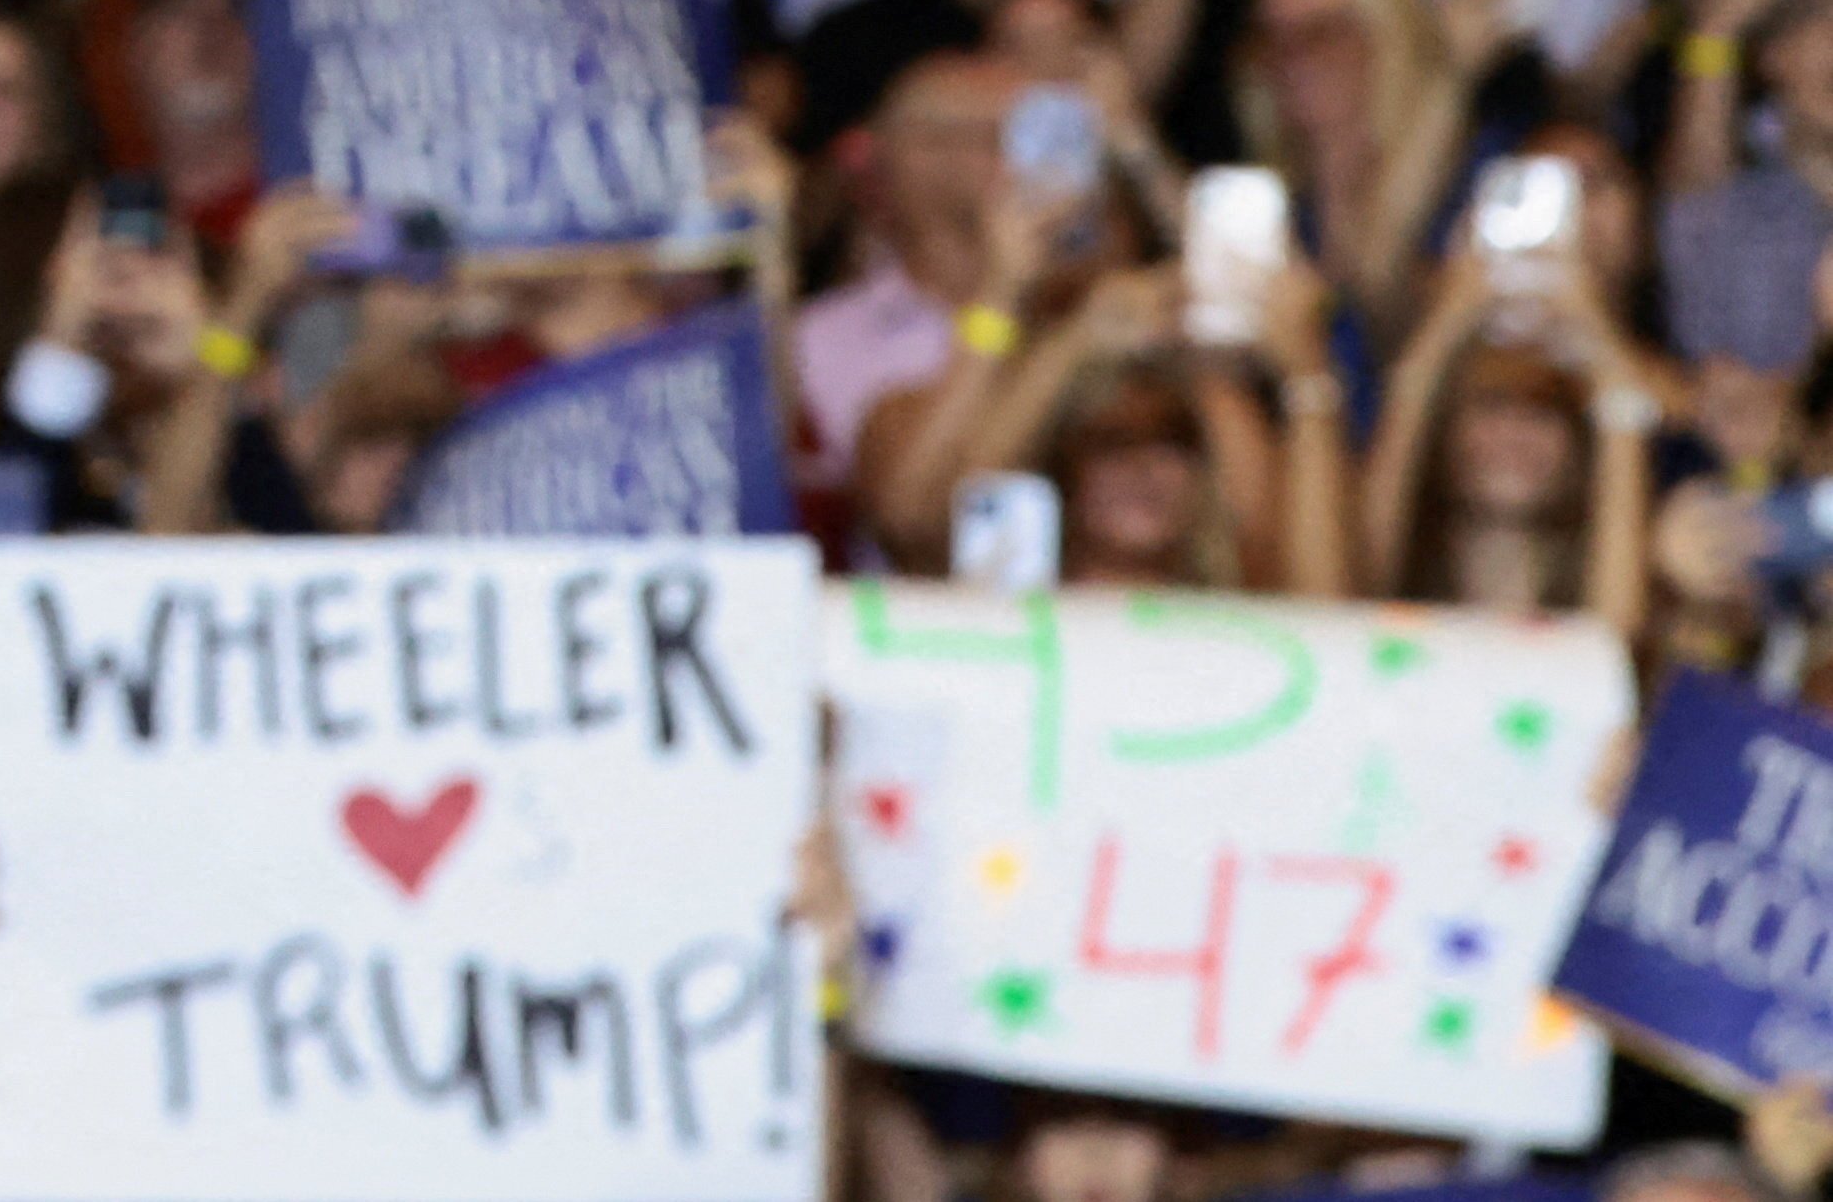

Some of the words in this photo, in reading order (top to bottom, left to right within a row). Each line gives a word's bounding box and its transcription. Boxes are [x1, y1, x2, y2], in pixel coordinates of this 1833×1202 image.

[305, 26, 701, 123] AMERICAN
[305, 100, 709, 234] DREAM
[27, 566, 757, 754] WHEELER
[85, 902, 801, 1152] TRUMP!
[1075, 828, 1395, 1064] 47
